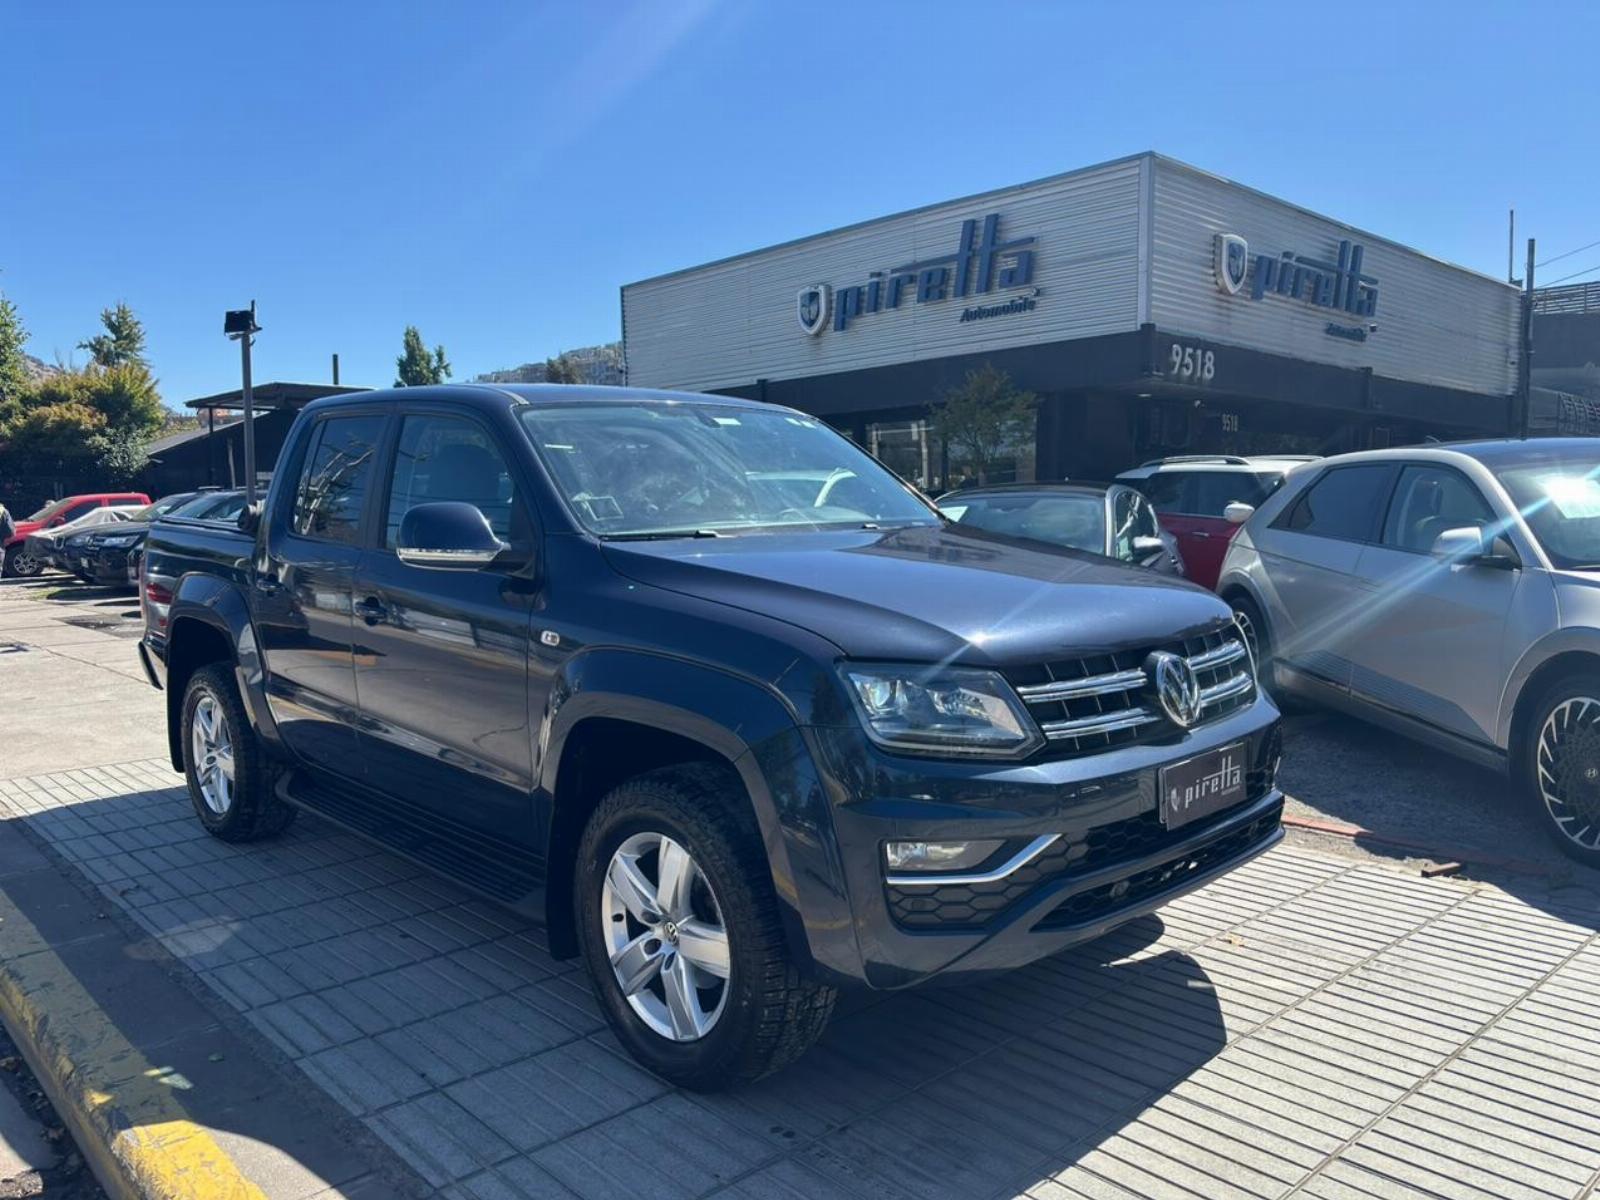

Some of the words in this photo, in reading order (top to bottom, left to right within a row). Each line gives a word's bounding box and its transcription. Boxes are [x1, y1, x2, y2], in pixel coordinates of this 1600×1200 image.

[833, 213, 1037, 331] piretta
[1251, 240, 1379, 317] piretta
[1171, 344, 1215, 380] 9518
[1184, 756, 1241, 809] piretta
